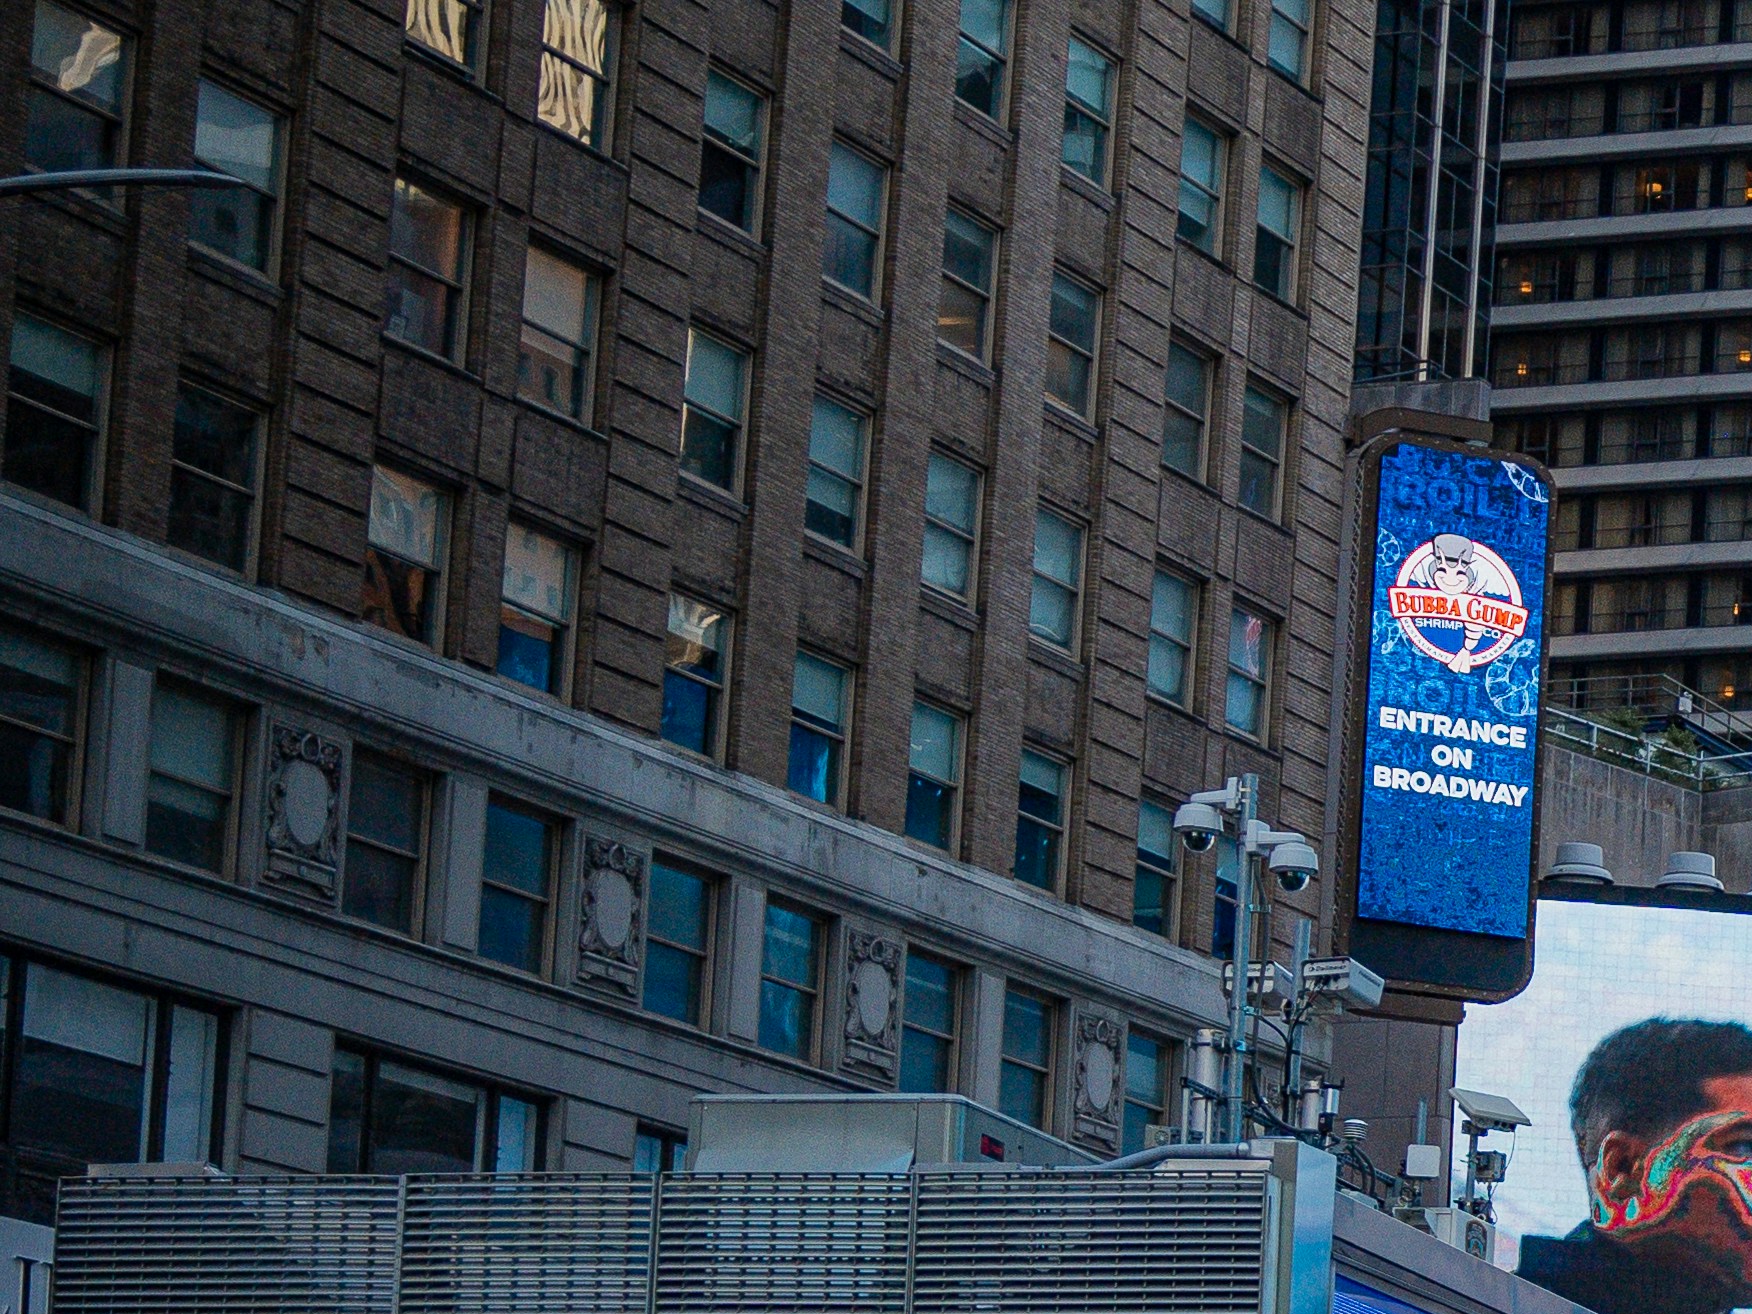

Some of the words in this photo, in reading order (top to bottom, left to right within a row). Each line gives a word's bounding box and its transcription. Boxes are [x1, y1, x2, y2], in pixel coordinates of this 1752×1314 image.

[1395, 591, 1463, 617] BUBBA
[1466, 598, 1524, 630] GUMP
[1415, 617, 1464, 631] SHRIMP
[1378, 706, 1528, 750] ENTRANCE
[1430, 743, 1473, 771] ON
[1373, 764, 1529, 808] BROADWAY
